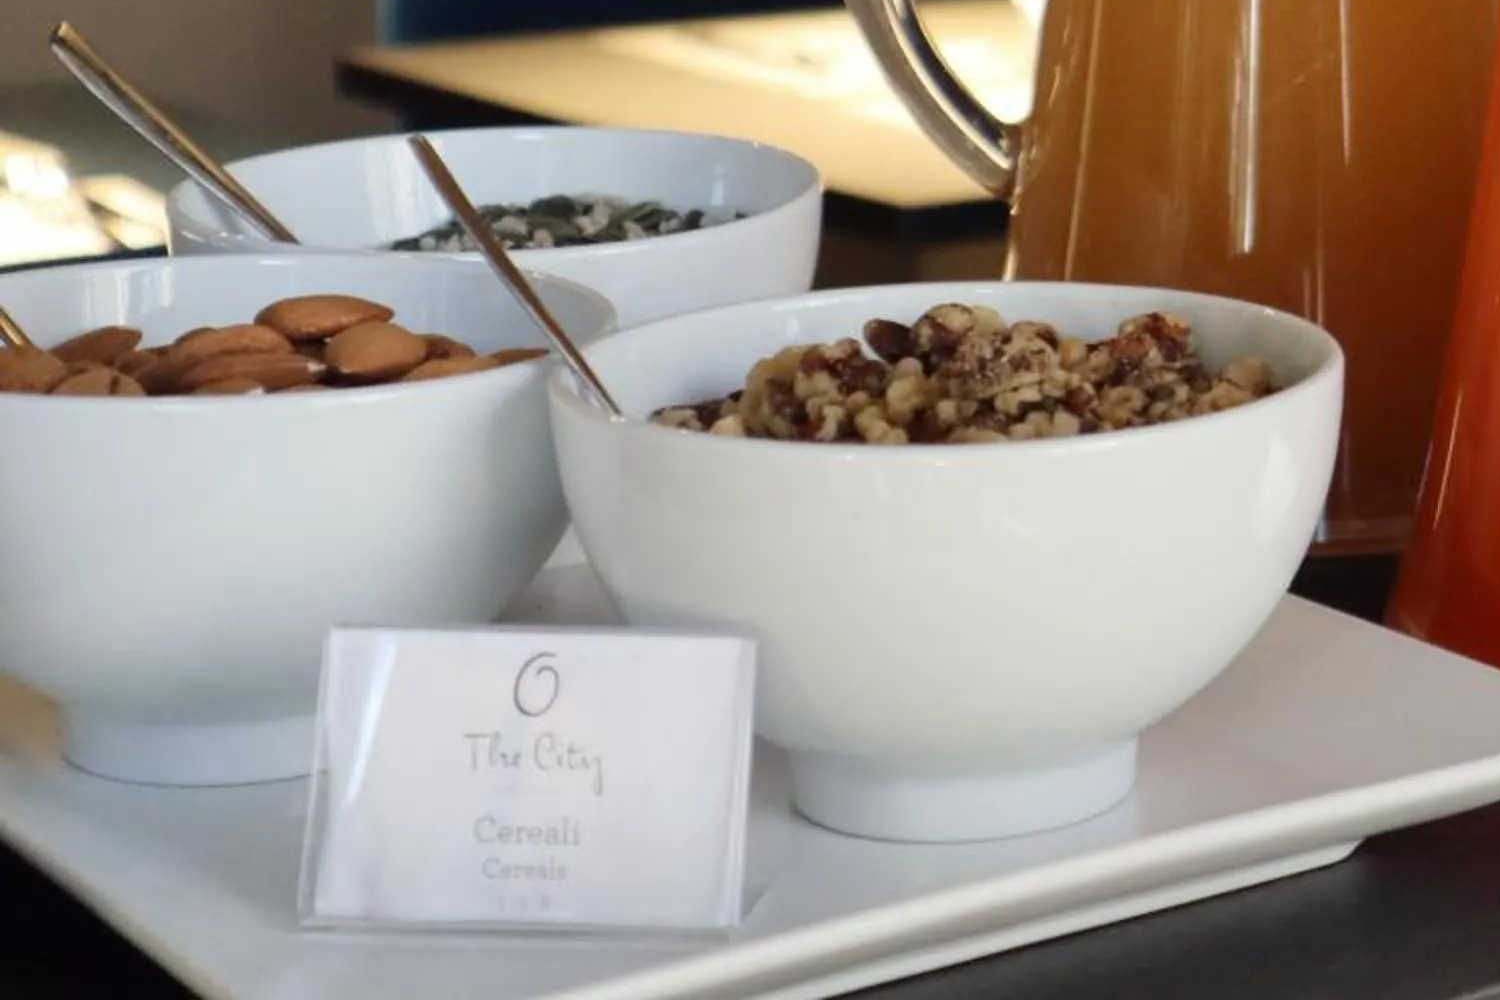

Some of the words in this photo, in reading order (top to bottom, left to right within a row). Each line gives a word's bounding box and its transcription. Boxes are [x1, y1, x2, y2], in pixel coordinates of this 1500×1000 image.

[463, 731, 522, 771] The
[533, 731, 604, 797] City
[472, 815, 581, 847] Cereali
